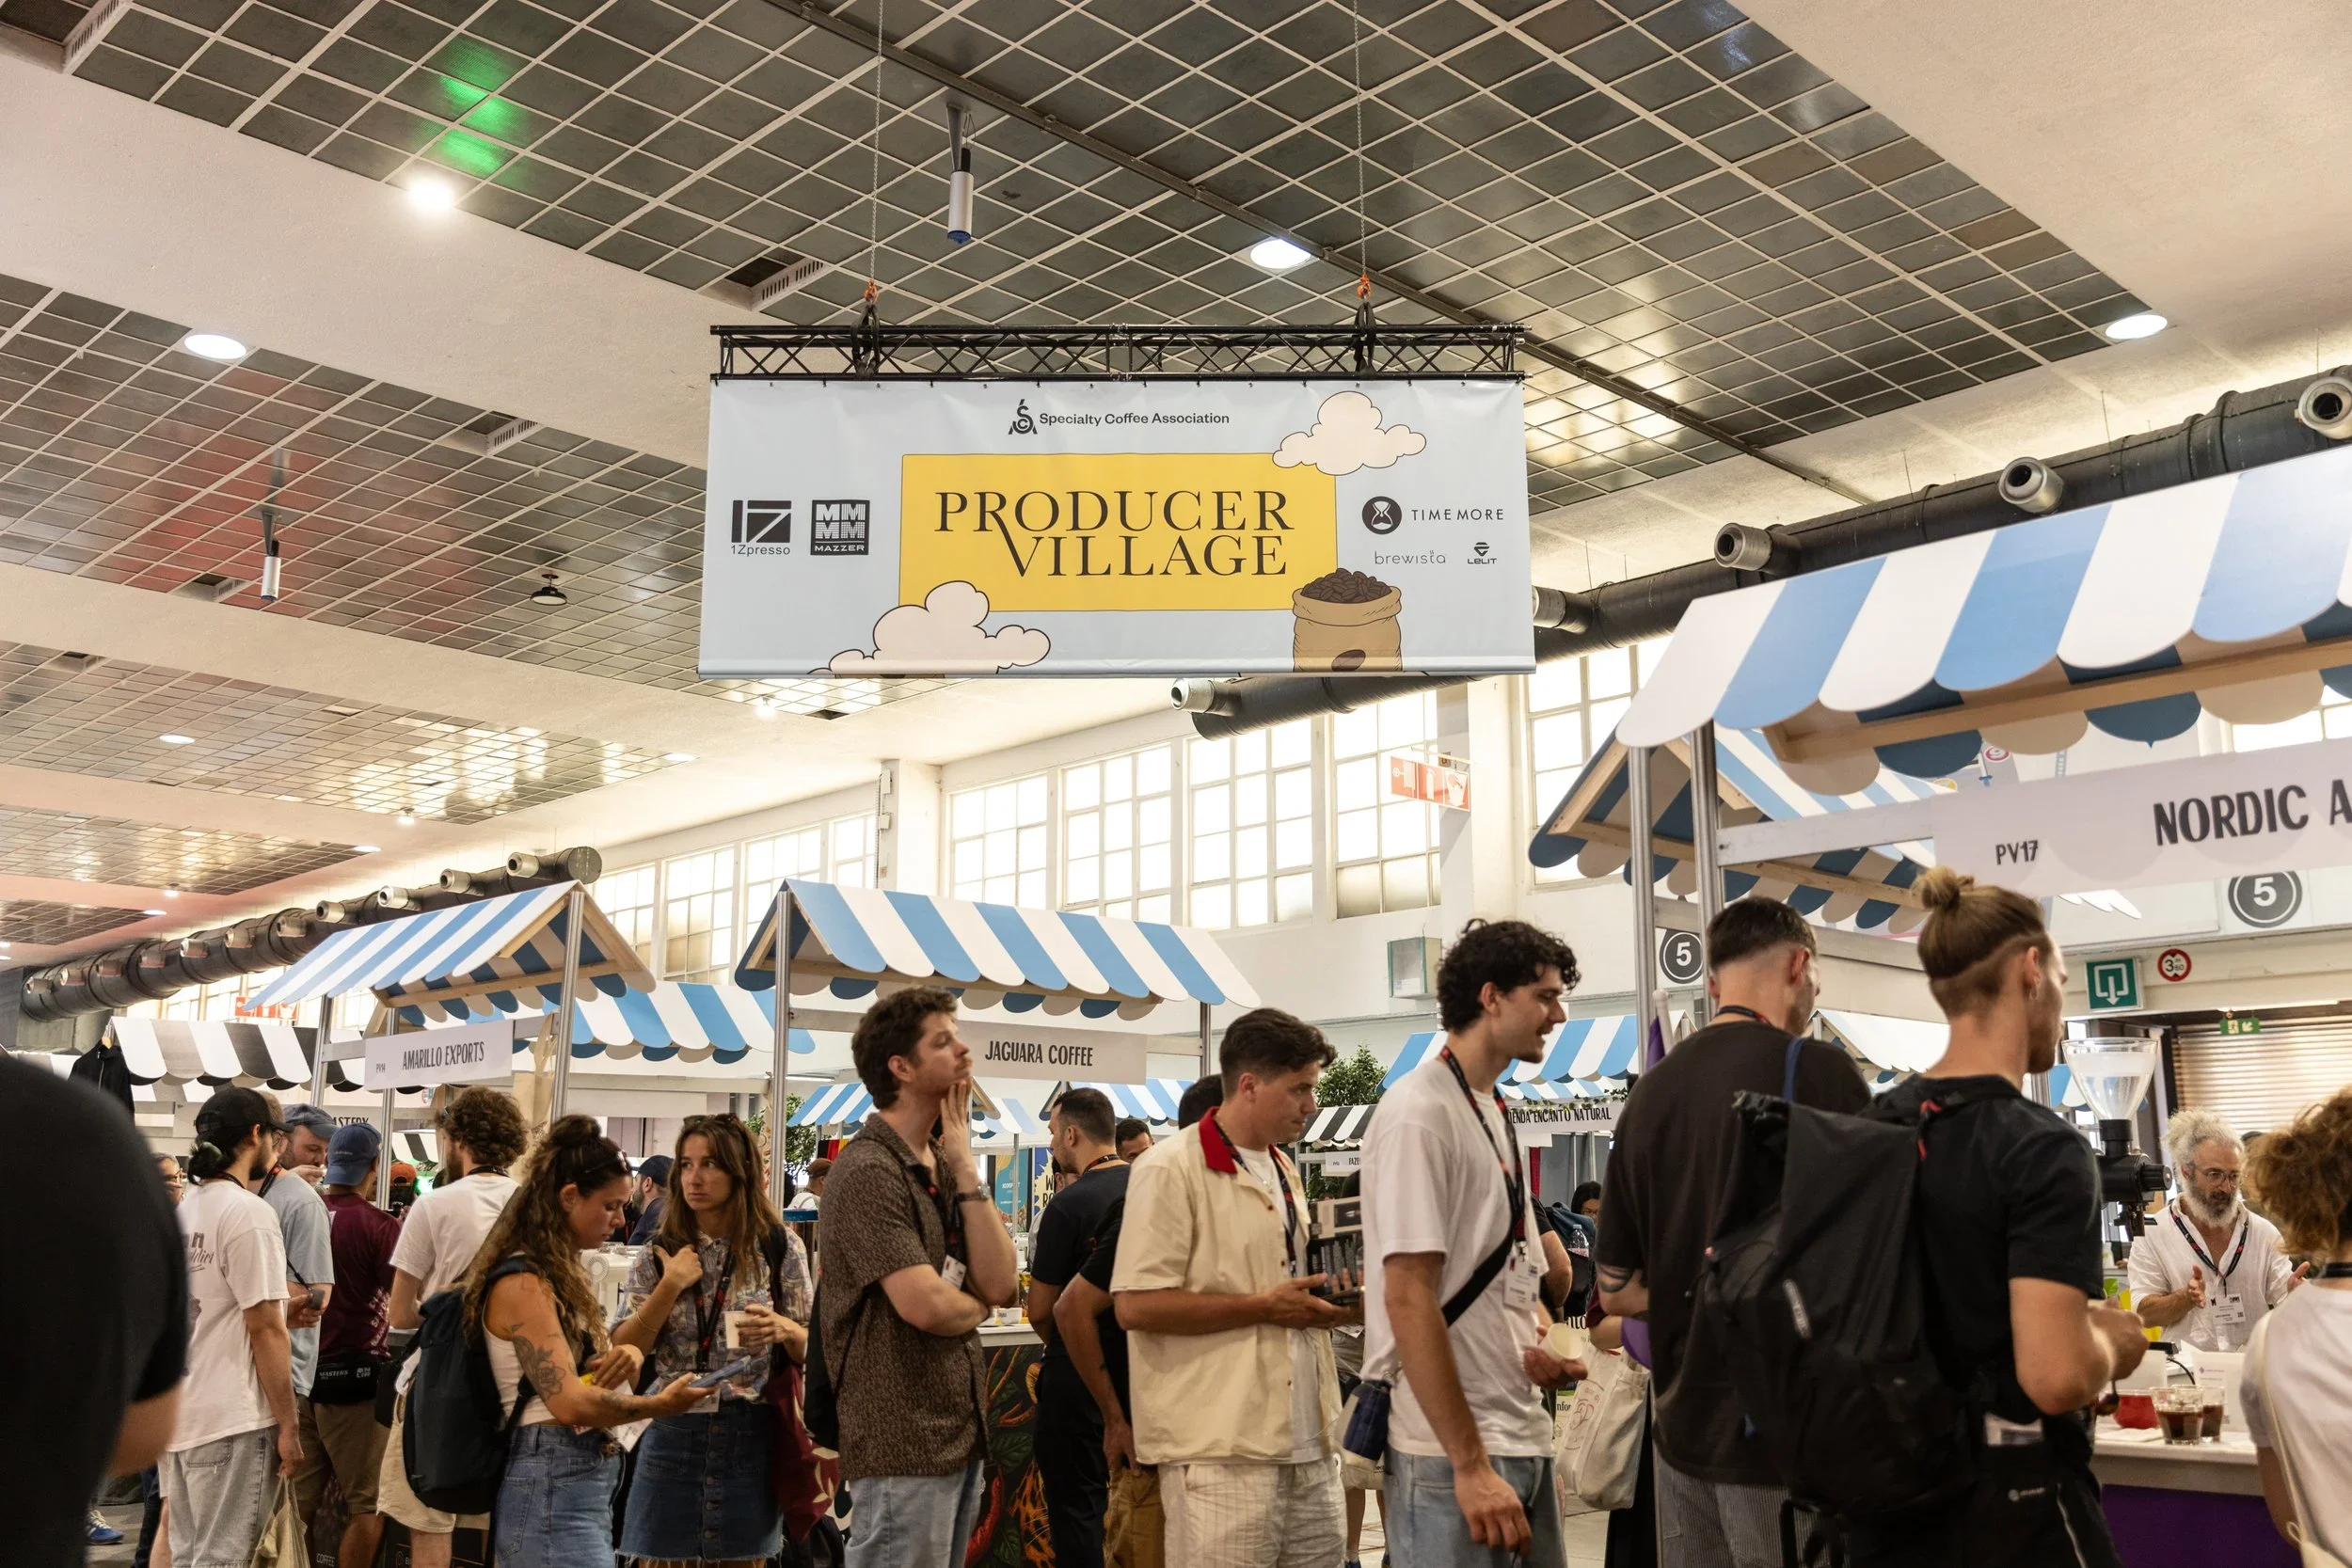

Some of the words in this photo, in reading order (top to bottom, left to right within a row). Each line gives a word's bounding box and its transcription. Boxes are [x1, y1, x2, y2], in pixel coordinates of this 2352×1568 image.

[1039, 413, 1102, 426] Specialty
[1104, 412, 1149, 423] Coffee
[1152, 412, 1230, 424] Association
[934, 490, 1295, 532] PRODUCER
[731, 544, 790, 557] 1Zpresso
[1009, 534, 1287, 577] VILLAGE
[1375, 550, 1446, 564] brewista
[2153, 784, 2310, 847] NORDIC
[1995, 840, 2039, 865] PV17
[2252, 876, 2278, 907] 5
[1676, 942, 1692, 966] 5
[403, 1046, 442, 1070] AMARILLO
[445, 1040, 485, 1066] EXPORTS
[985, 1040, 1043, 1063] JAGUARA
[1049, 1044, 1093, 1067] COFFEE
[1508, 1110, 1531, 1124] IENDA
[1573, 1107, 1613, 1121] NATURAL
[316, 1553, 335, 1567] COFFEE
